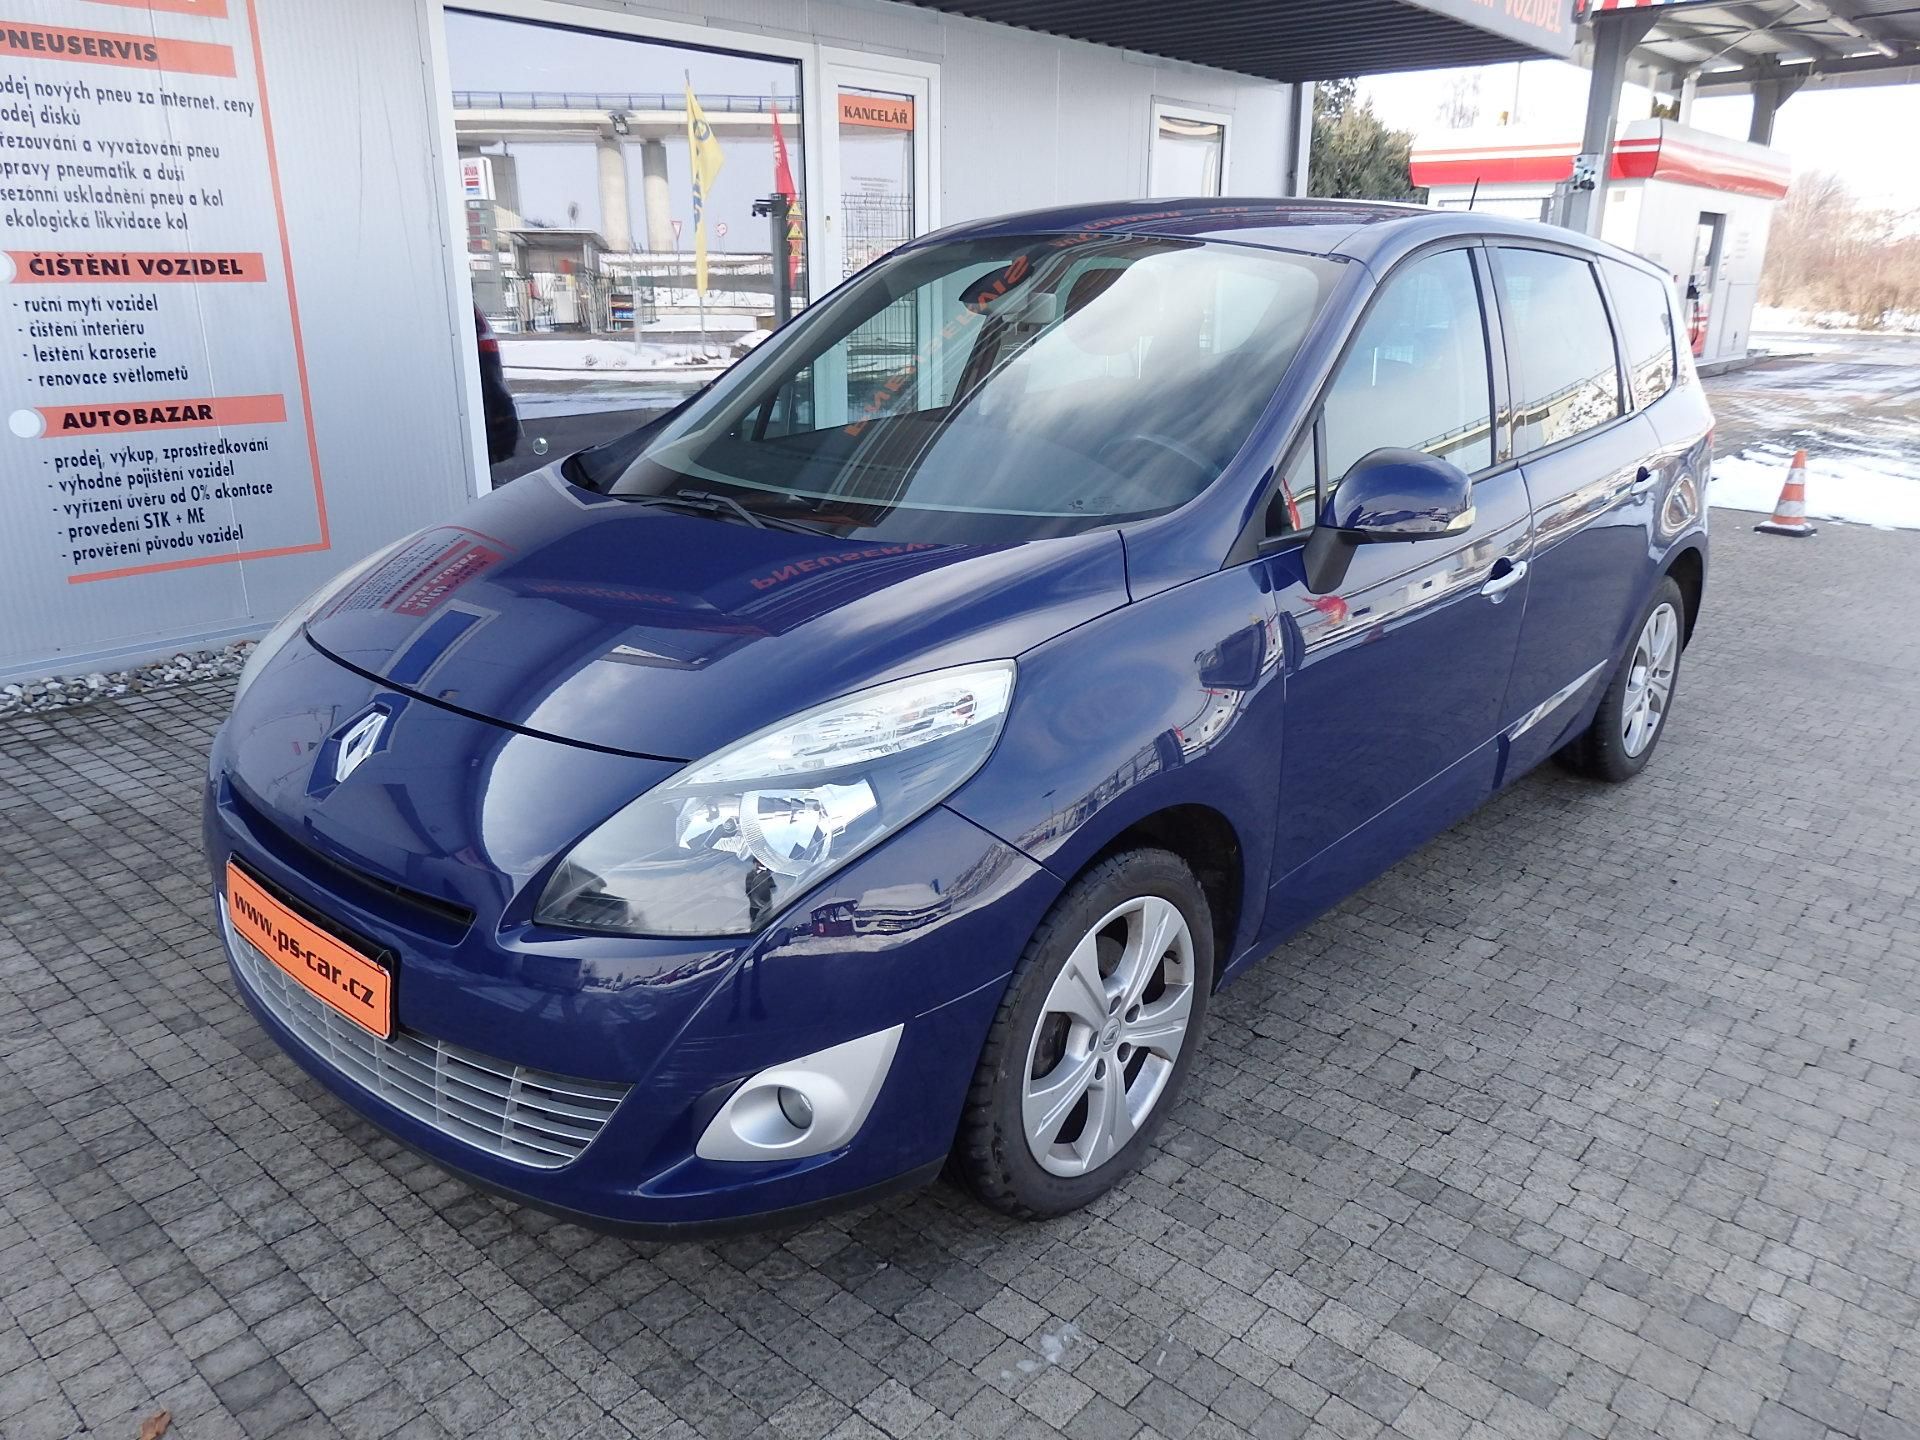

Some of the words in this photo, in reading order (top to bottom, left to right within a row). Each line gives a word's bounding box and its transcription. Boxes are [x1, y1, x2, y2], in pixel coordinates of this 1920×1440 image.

[34, 80, 91, 103] nových
[96, 88, 132, 105] pneu
[137, 91, 155, 105] za
[159, 87, 220, 110] internet.
[224, 99, 254, 117] ceny
[40, 104, 81, 126] disků
[844, 105, 908, 124] KANCELÁŘ
[82, 140, 92, 152] a
[97, 138, 182, 158] vyvažování
[187, 145, 220, 162] pneu
[57, 160, 138, 181] pneumatik
[143, 168, 152, 180] a
[0, 184, 59, 202] sezónní
[63, 184, 146, 206] uskladnění
[150, 192, 184, 209] pneu
[189, 194, 197, 206] a
[201, 188, 224, 206] kol
[5, 208, 90, 232] ekologická
[94, 210, 161, 229] likvidace
[165, 211, 188, 230] kol
[29, 252, 130, 276] ČIŠTĚNÍ
[137, 258, 244, 276] VOZIDEL
[24, 296, 63, 313] ruční
[67, 296, 102, 317] mytí
[106, 293, 159, 312] vozidel
[29, 319, 79, 338] čištění
[81, 318, 145, 337] interiéru
[33, 343, 85, 363] leštění
[88, 342, 157, 361] karoserie
[39, 371, 108, 387] renovace
[113, 364, 189, 384] světlometů
[62, 404, 214, 430] AUTOBAZAR
[54, 448, 106, 473] prodej,
[110, 445, 158, 468] výkup,
[162, 436, 269, 464] zprostředkování
[59, 471, 122, 496] výhodné
[127, 466, 184, 490] pojištění
[188, 459, 235, 480] vozidel
[63, 494, 123, 519] vyřízení
[127, 492, 166, 510] úvěru
[170, 486, 187, 504] od
[190, 483, 211, 502] 0%
[215, 482, 273, 499] akontace
[68, 515, 140, 543] provedení
[143, 511, 171, 530] STK
[187, 507, 206, 524] ME
[73, 537, 141, 566] prověření
[146, 531, 194, 556] původu
[197, 523, 244, 545] vozidel
[234, 891, 376, 1009] www.ps-car.cz
